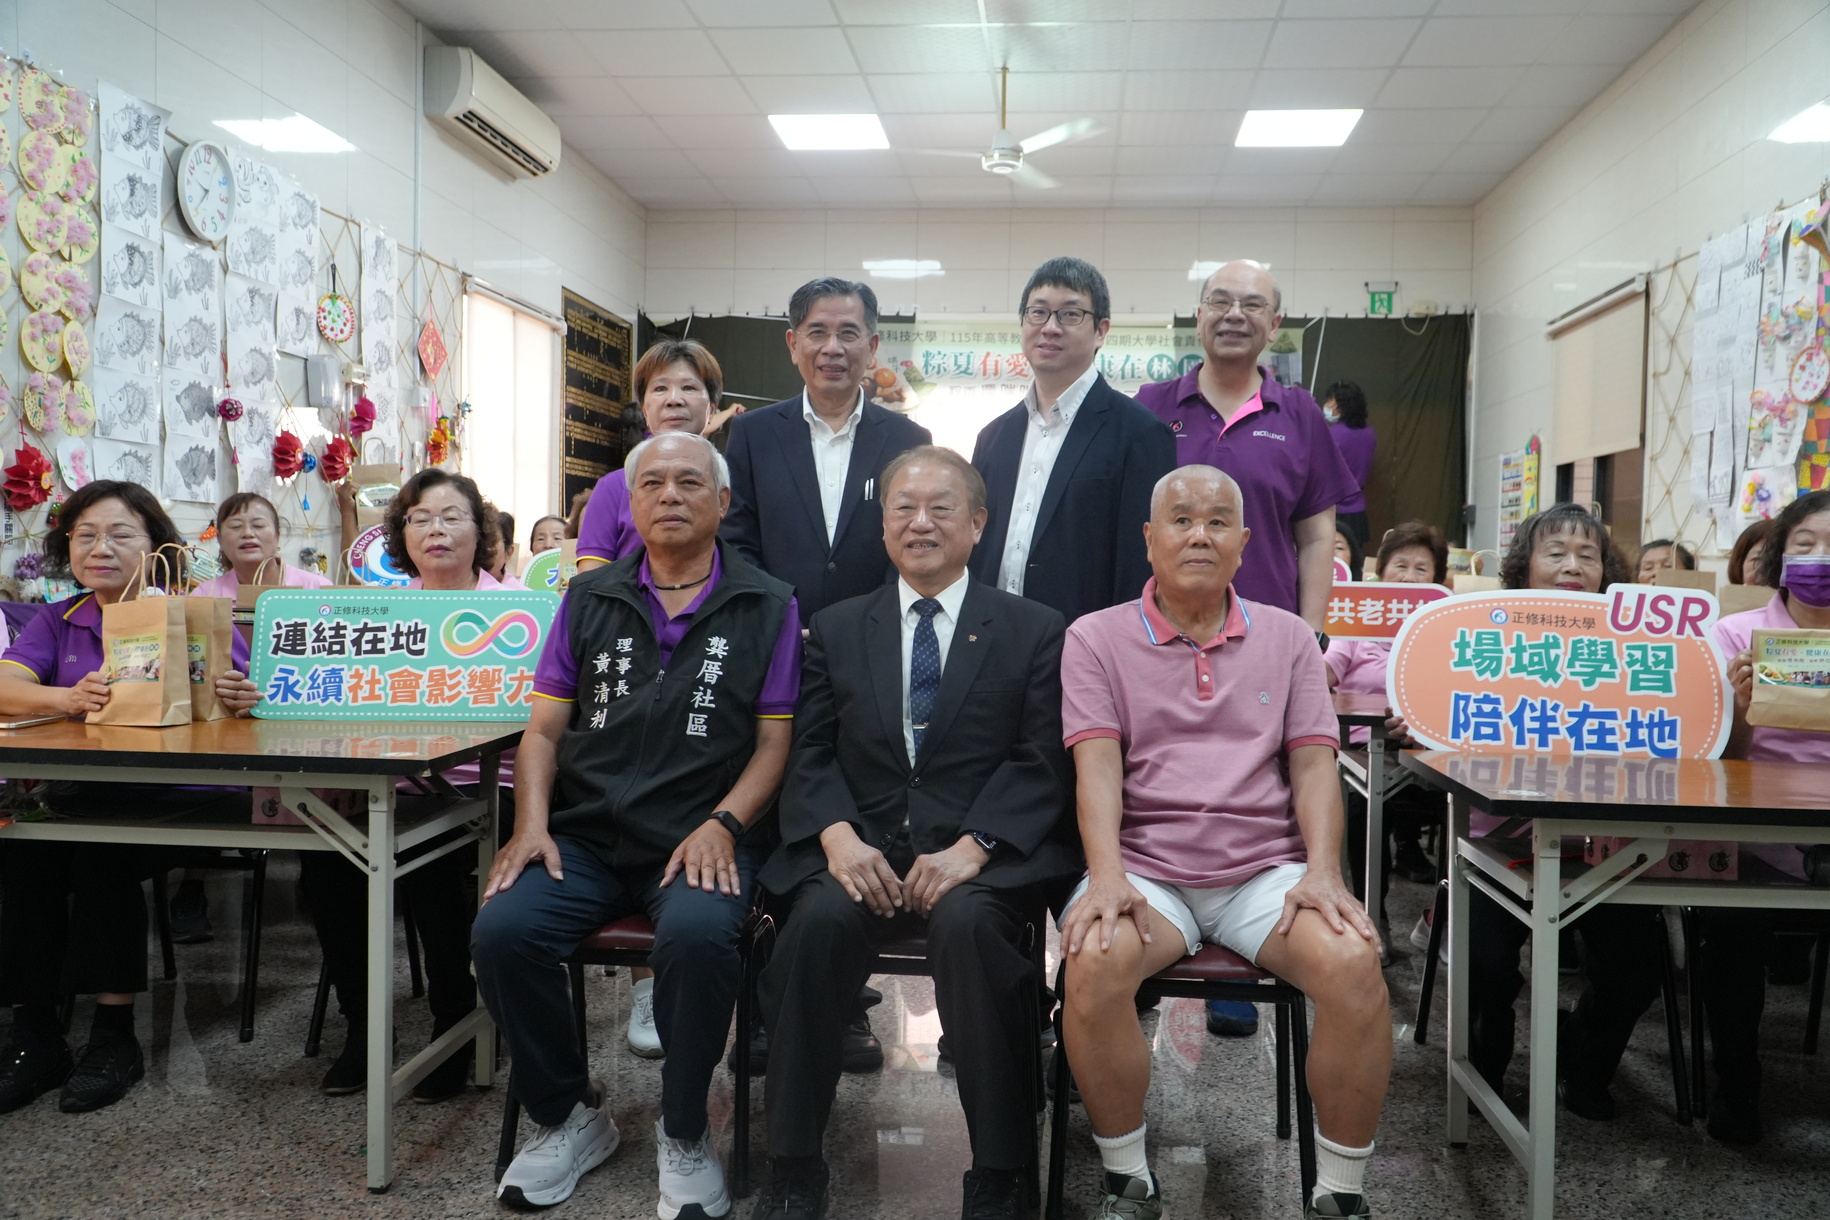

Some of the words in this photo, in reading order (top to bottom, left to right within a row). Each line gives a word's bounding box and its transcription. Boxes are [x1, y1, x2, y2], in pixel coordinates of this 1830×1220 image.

[1106, 334, 1203, 347] 四期大學社會責
[922, 350, 1030, 379] 粽夏有愛
[1253, 430, 1286, 441] EXCELLENCE
[333, 606, 388, 616] 正修科技大學
[1327, 597, 1431, 626] 共老共
[1512, 611, 1596, 629] 正修科技大學
[1610, 591, 1711, 638] USR
[270, 620, 427, 657] 連結在地
[613, 637, 633, 698] 理事長
[1452, 629, 1675, 694] 場域學習
[267, 667, 535, 706] 永續社會影響力
[589, 652, 612, 729] 黃清利
[685, 635, 729, 738] 龔厝社區
[1450, 692, 1679, 759] 陪伴在地
